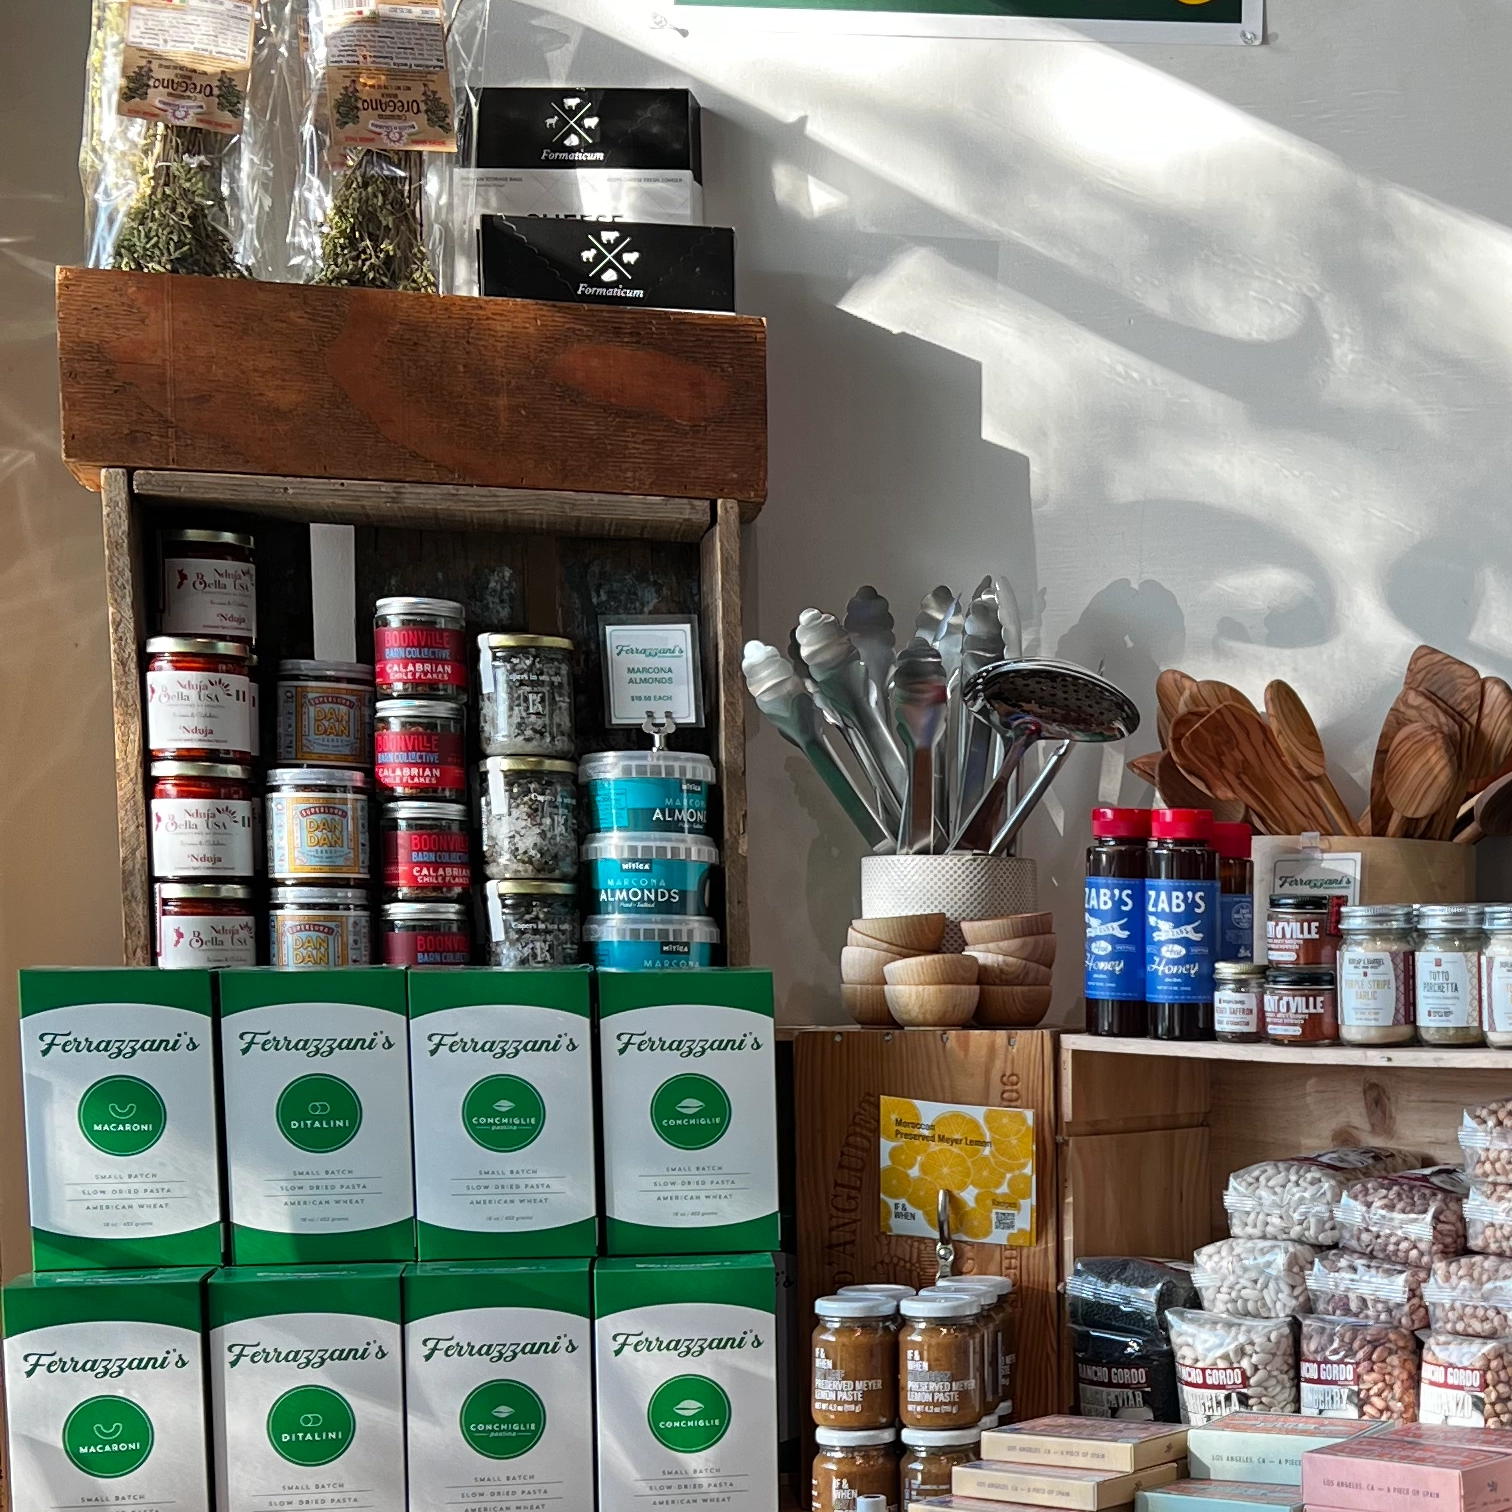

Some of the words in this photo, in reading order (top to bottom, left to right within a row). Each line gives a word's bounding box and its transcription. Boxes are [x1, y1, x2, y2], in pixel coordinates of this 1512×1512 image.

[541, 149, 604, 162] Formaticum
[577, 283, 644, 298] Formaticum
[615, 645, 684, 658] Ferrazzani's
[386, 663, 451, 673] CALABRIAN
[306, 818, 342, 833] DAN
[306, 833, 343, 847] DAN
[600, 888, 679, 902] ALMONDS
[1148, 891, 1206, 913] ZAB'S
[1148, 954, 1199, 977] Honey
[38, 1031, 200, 1059] Ferrazzani's
[239, 1030, 395, 1057] Ferrazzani's
[427, 1032, 579, 1059] Ferrazzani's
[616, 1031, 763, 1058] Ferrazzani's
[93, 1123, 153, 1132] MACARONI
[290, 1119, 349, 1129] DITALINI
[472, 1116, 536, 1125] CONCHIGLIE
[662, 1117, 721, 1127] CONCHIGLIE
[895, 1129, 935, 1142] Preserved
[938, 1134, 963, 1147] Meyer
[965, 1136, 992, 1147] Lemon
[894, 1203, 900, 1211] IF
[894, 1212, 915, 1221] WHEN
[1111, 1367, 1147, 1383] GORDO
[1203, 1369, 1242, 1386] GORDO
[815, 1381, 853, 1390] PRESERVED
[856, 1379, 882, 1389] MEYER
[815, 1391, 836, 1400] LEMON
[838, 1391, 863, 1401] PASTE
